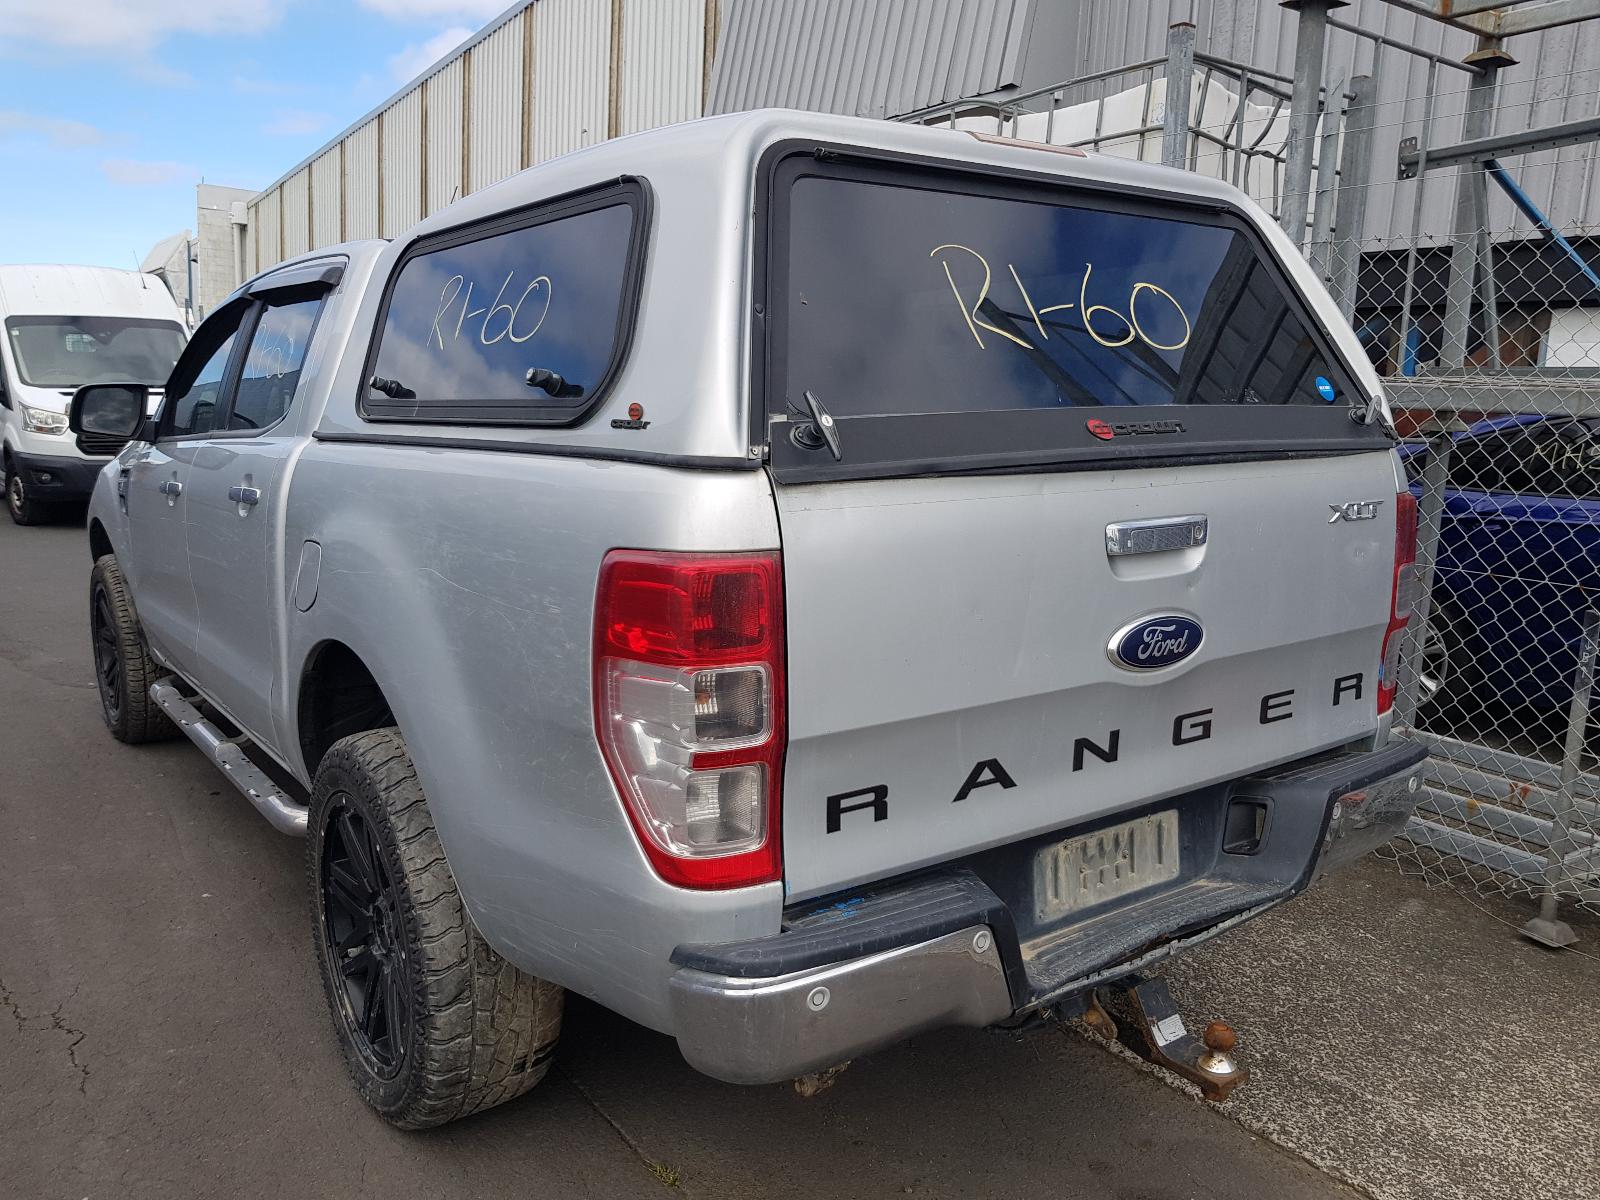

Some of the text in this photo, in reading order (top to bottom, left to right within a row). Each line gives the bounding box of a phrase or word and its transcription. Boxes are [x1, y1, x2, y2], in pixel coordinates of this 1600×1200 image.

[427, 270, 552, 351] R1-60
[926, 244, 1191, 350] R1-60
[1328, 500, 1385, 524] XLT
[1137, 624, 1189, 660] Ford
[826, 672, 1363, 834] RANGER
